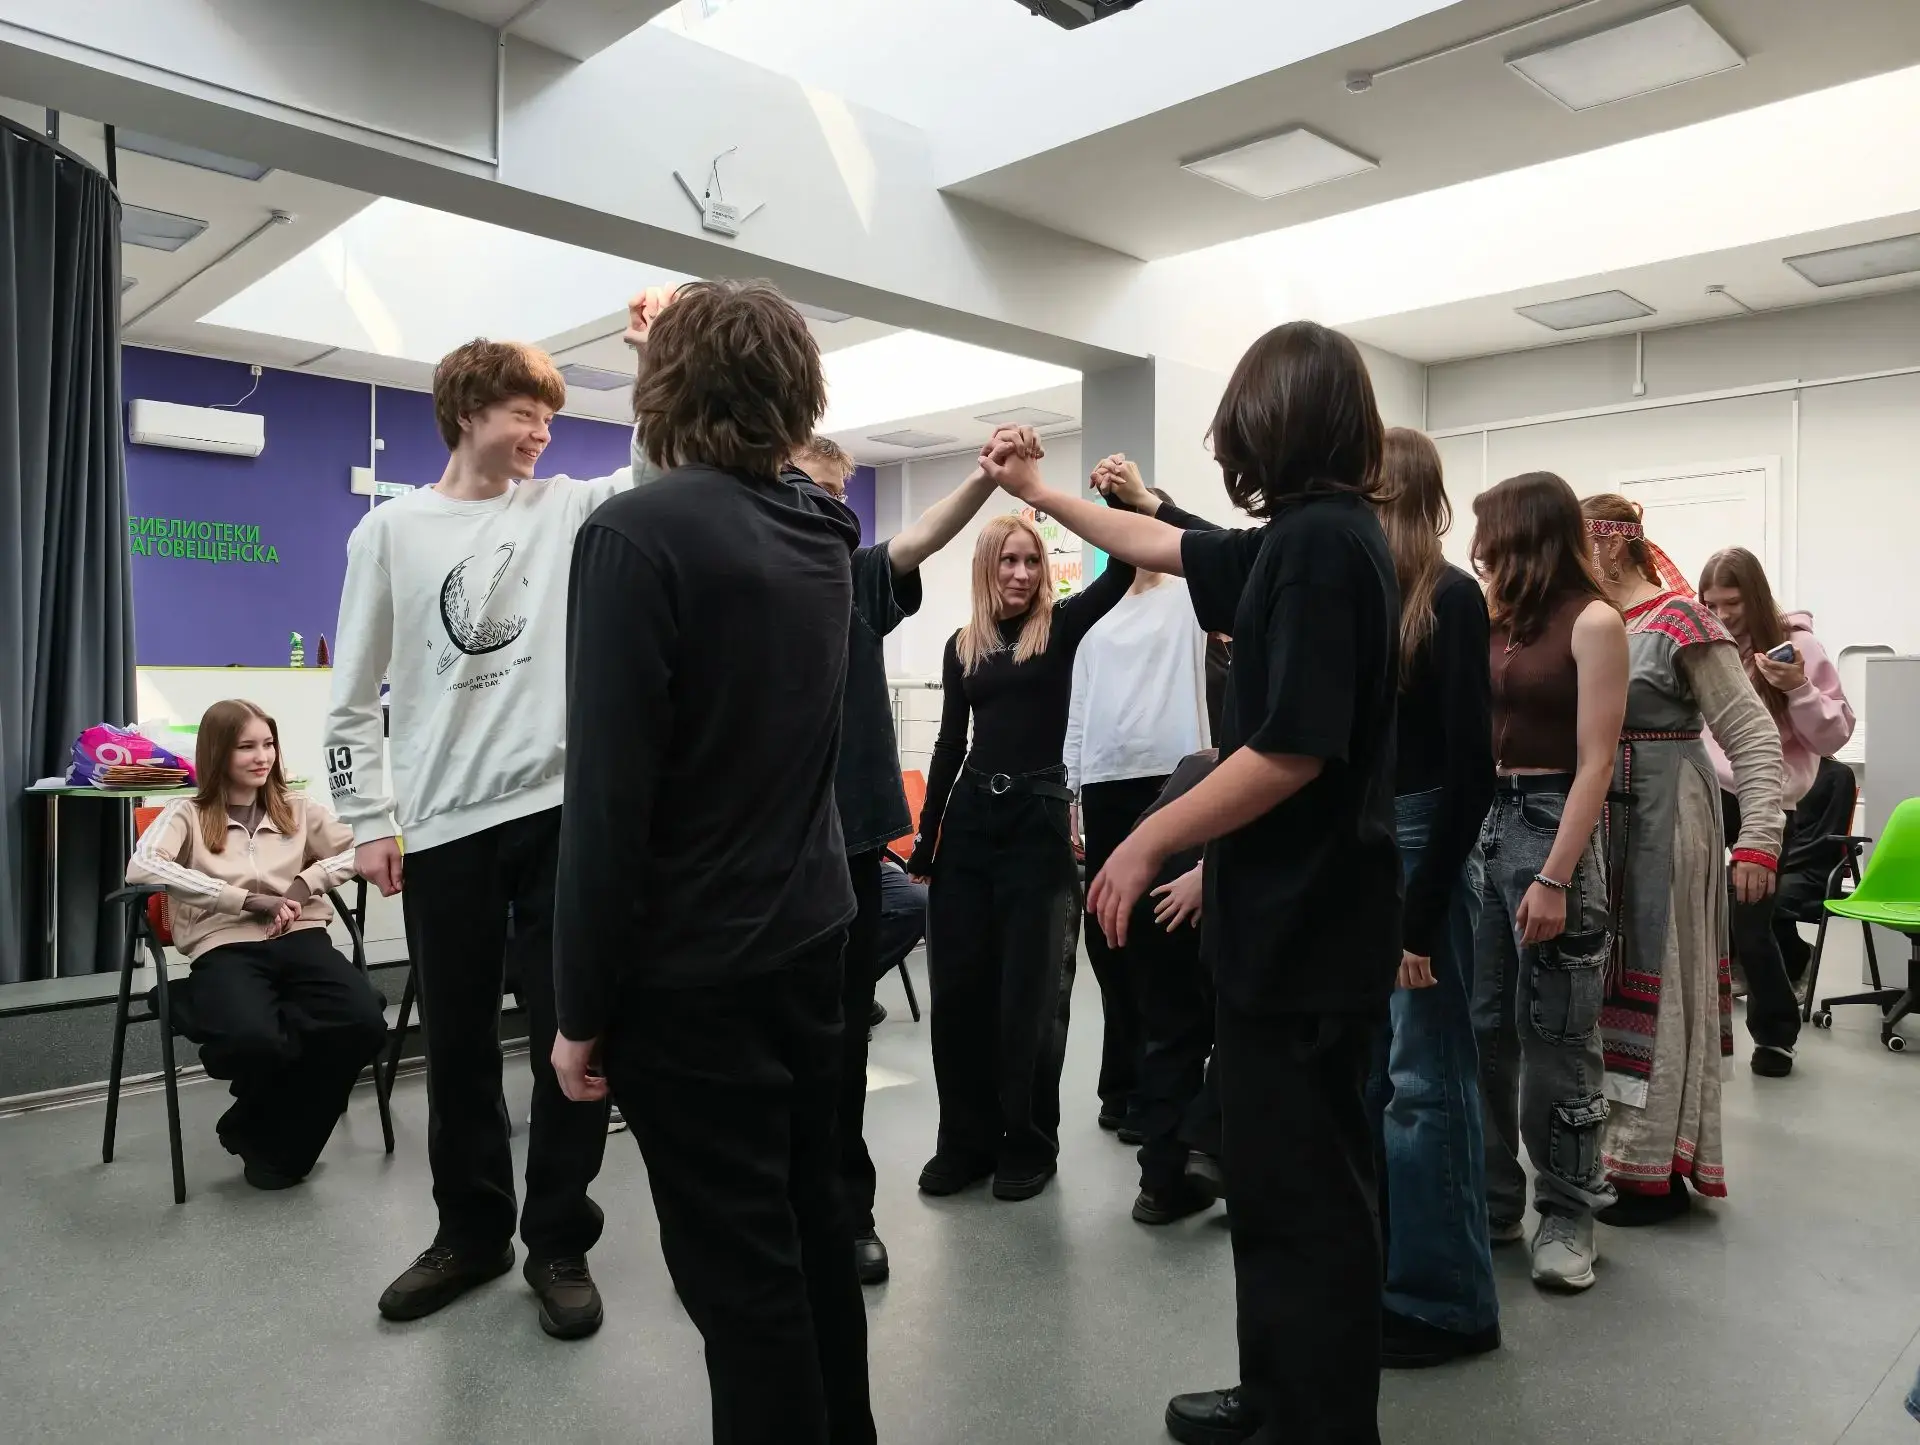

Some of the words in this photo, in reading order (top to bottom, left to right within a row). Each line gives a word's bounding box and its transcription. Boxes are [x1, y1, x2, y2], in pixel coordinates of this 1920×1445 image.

[128, 515, 260, 543] БИБЛИОТЕКИ
[131, 536, 280, 563] АГОВЕЩЕНСКА
[490, 672, 498, 680] IN
[469, 682, 483, 692] ONE
